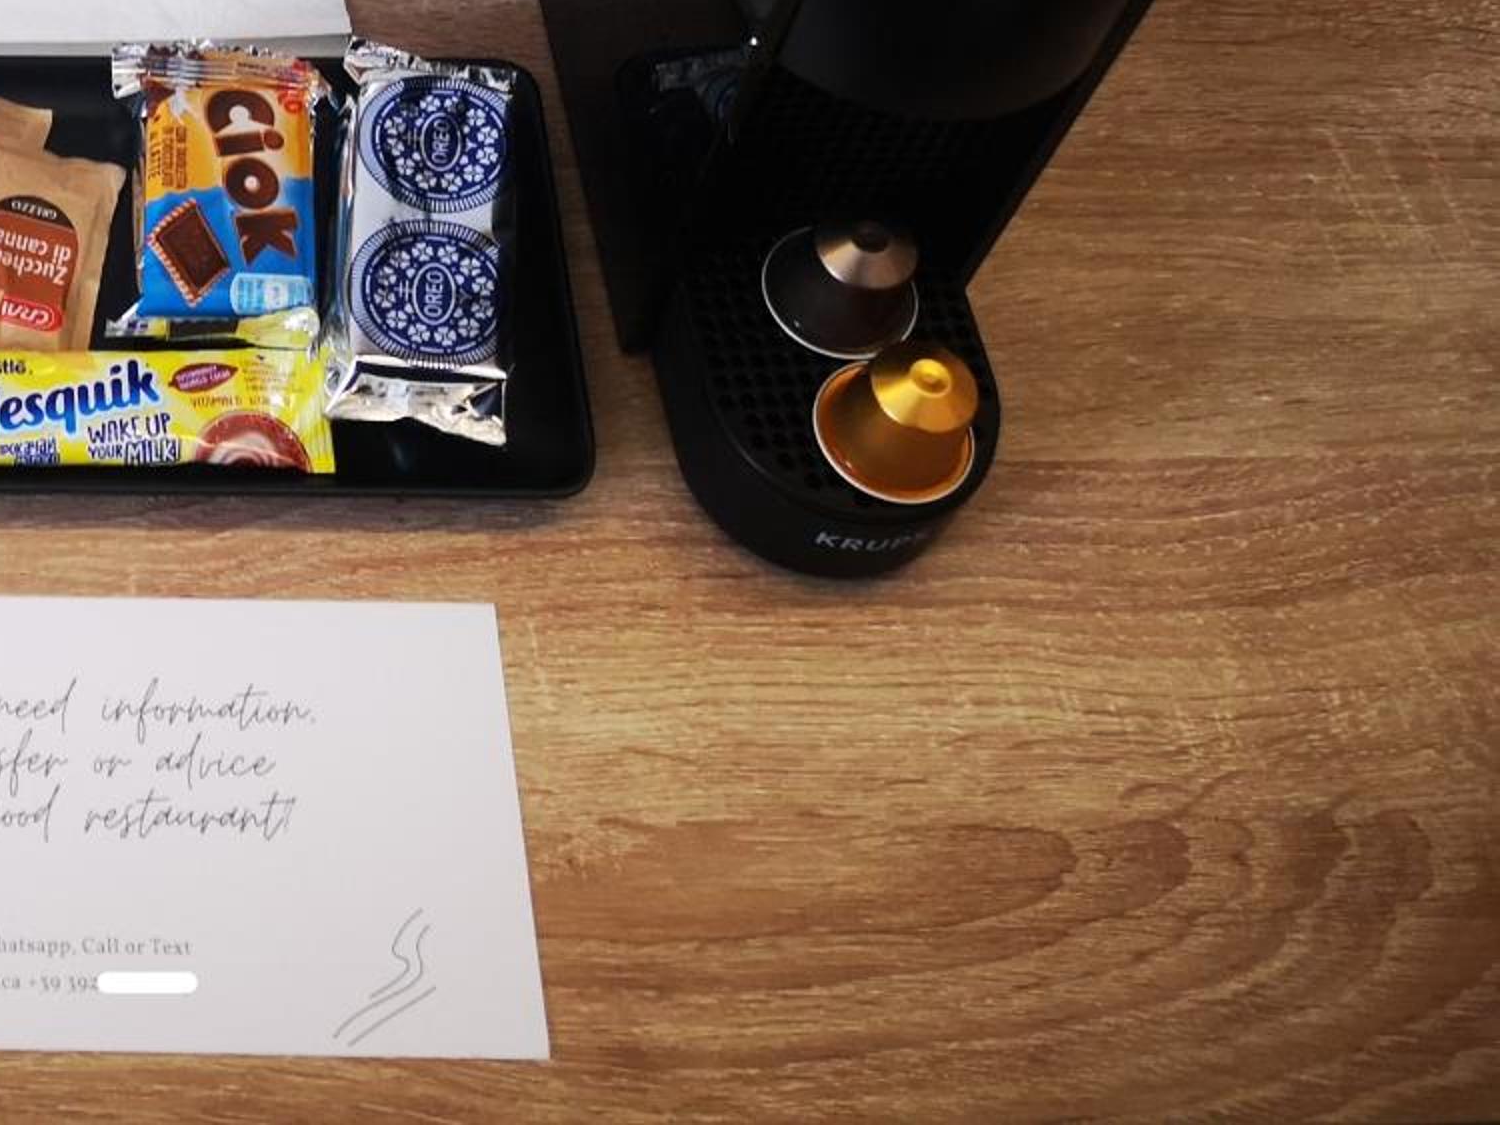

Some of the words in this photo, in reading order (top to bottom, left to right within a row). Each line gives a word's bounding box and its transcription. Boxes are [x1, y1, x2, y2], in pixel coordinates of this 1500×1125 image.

[431, 119, 450, 164] OREO
[52, 244, 72, 264] di
[423, 270, 444, 318] OREO
[87, 414, 140, 444] WAKE
[145, 412, 172, 438] UP
[88, 442, 123, 461] YOUR
[93, 754, 132, 778] or
[155, 732, 277, 790] advice
[81, 937, 120, 956] Call
[125, 940, 145, 955] or
[150, 938, 193, 956] Text
